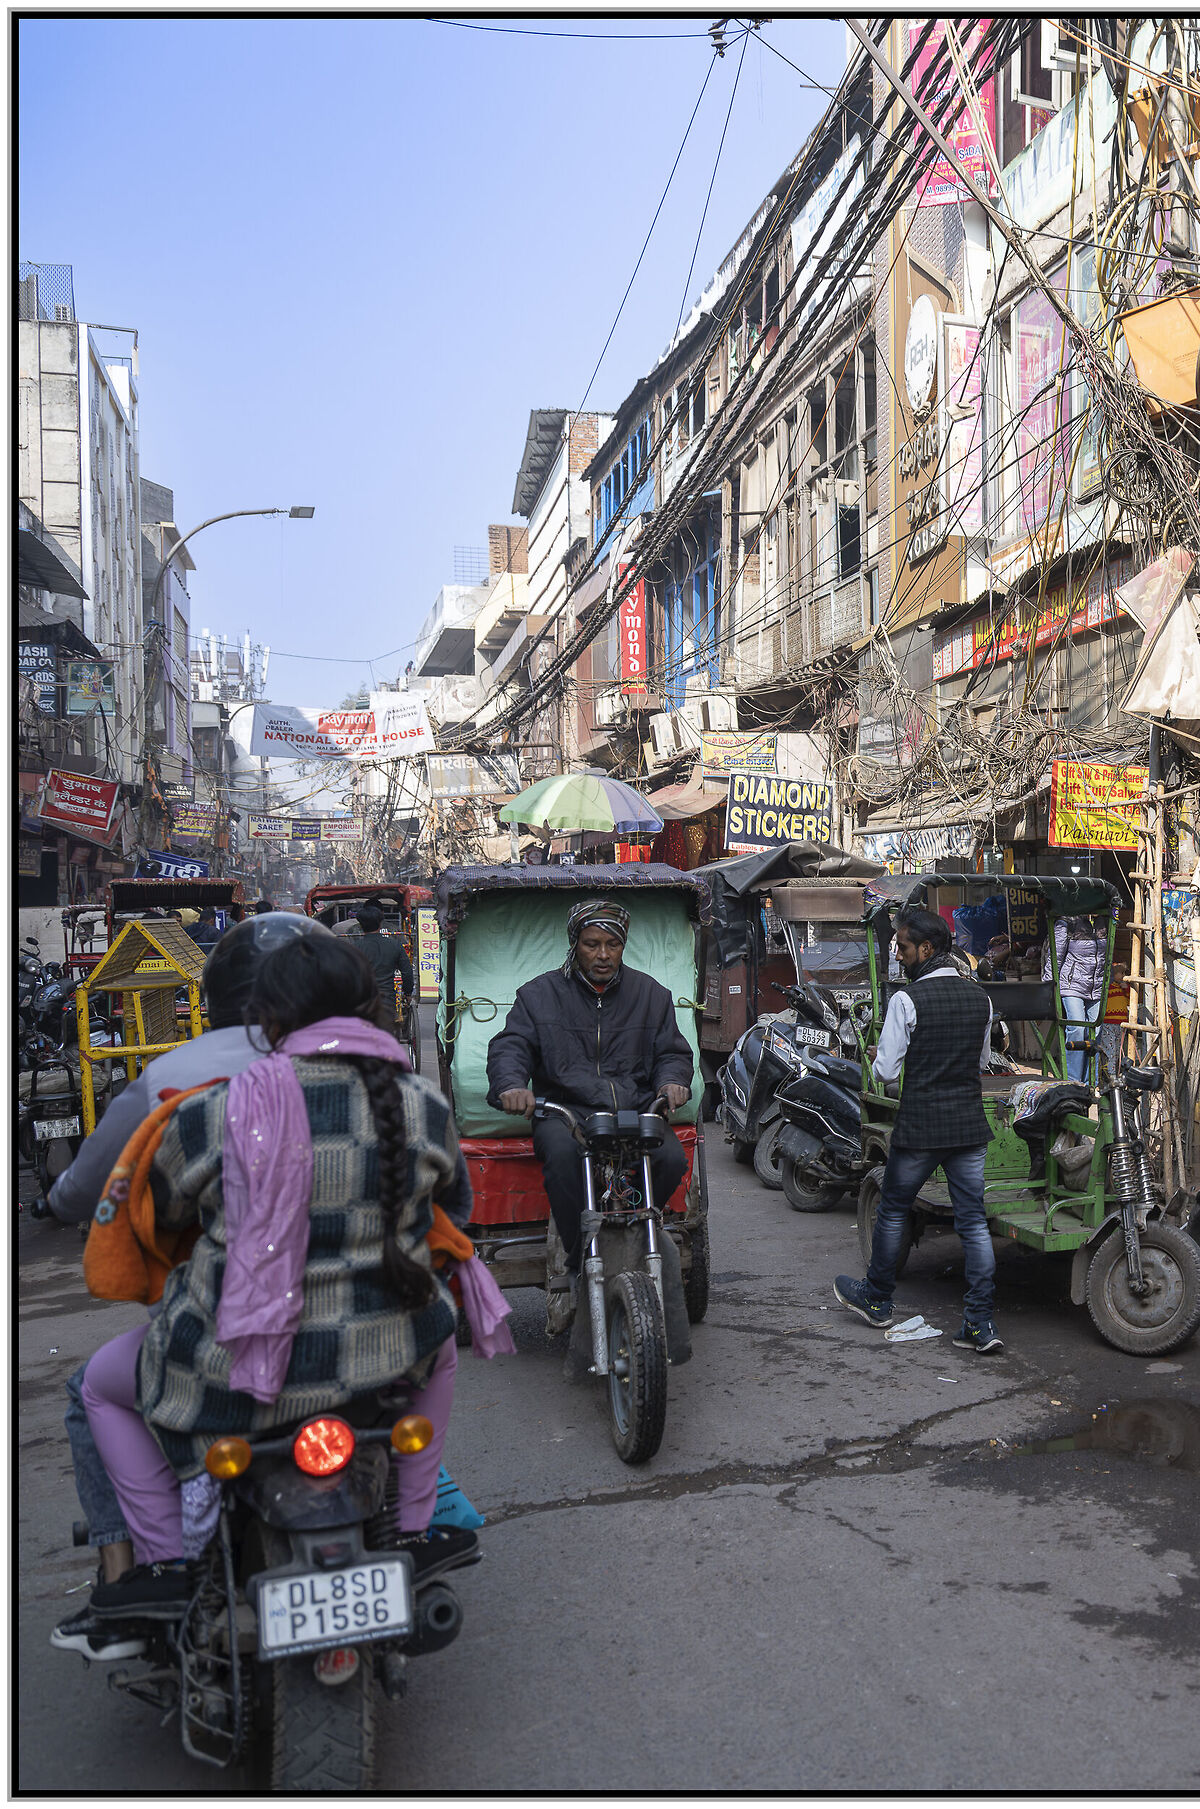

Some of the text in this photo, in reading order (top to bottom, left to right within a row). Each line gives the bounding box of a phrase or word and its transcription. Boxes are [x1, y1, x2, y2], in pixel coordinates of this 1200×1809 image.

[19, 646, 48, 657] ASH
[264, 727, 425, 745] NATIONAL CLOTH HOUSE
[1061, 766, 1076, 780] Gift
[1094, 769, 1100, 781] &
[733, 775, 830, 811] DIAMOND
[1061, 782, 1081, 796] Gift
[729, 806, 830, 842] STICKERS
[1059, 823, 1131, 842] Vaisnavi
[289, 1568, 387, 1608] DL8SD
[291, 1598, 390, 1639] P1596
